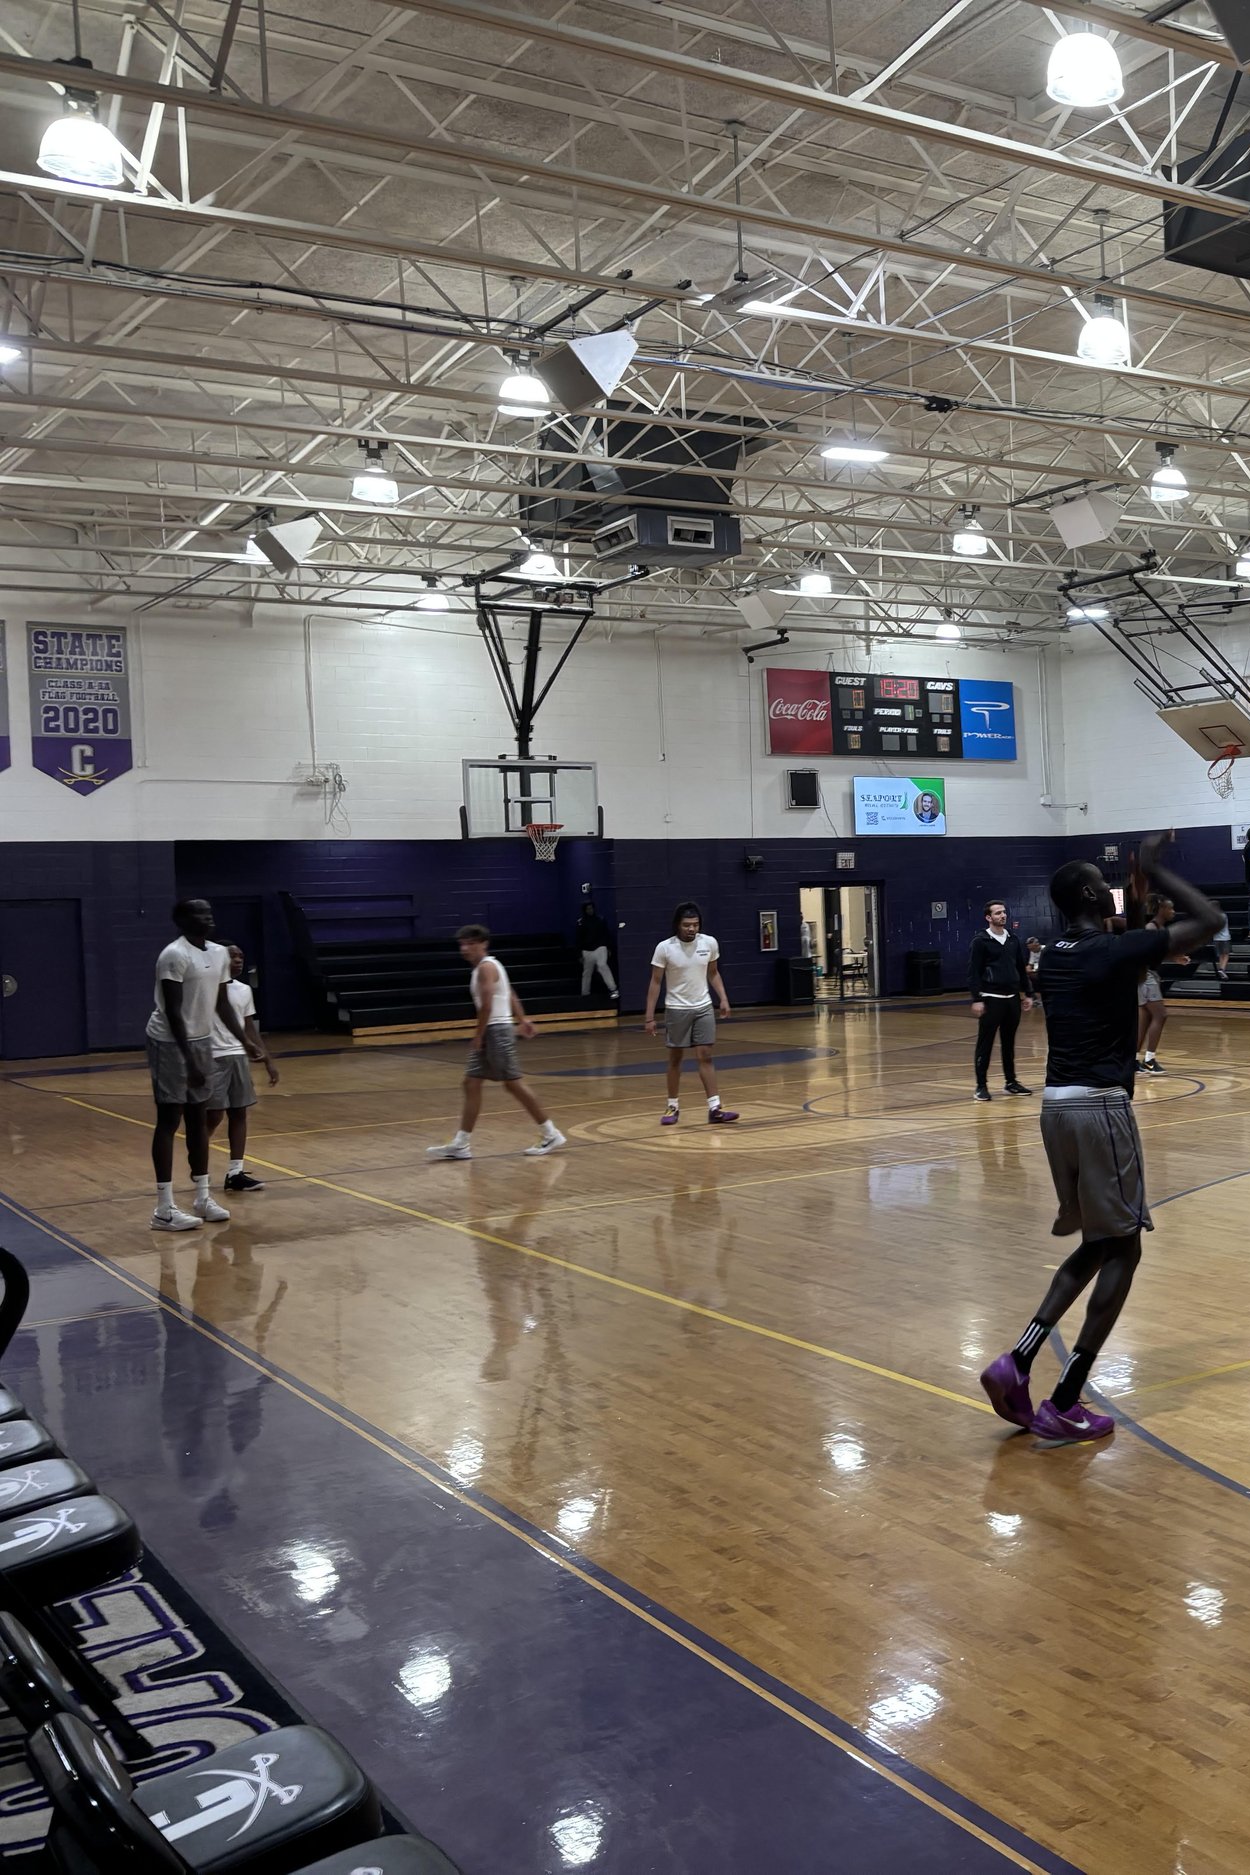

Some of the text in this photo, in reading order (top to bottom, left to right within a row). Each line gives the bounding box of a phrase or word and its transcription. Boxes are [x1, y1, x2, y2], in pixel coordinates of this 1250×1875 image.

[32, 629, 123, 659] STATE
[33, 655, 123, 673] CHAMPIONS
[47, 679, 84, 690] CLASS
[834, 676, 867, 687] GUEST
[926, 681, 954, 691] CAVS
[41, 690, 119, 703] FLAG FOOTBALL
[769, 698, 830, 721] Coca-Cola
[874, 708, 902, 716] PERIOD
[42, 705, 120, 736] 2020
[71, 744, 95, 777] C
[860, 795, 903, 803] SEAPORT
